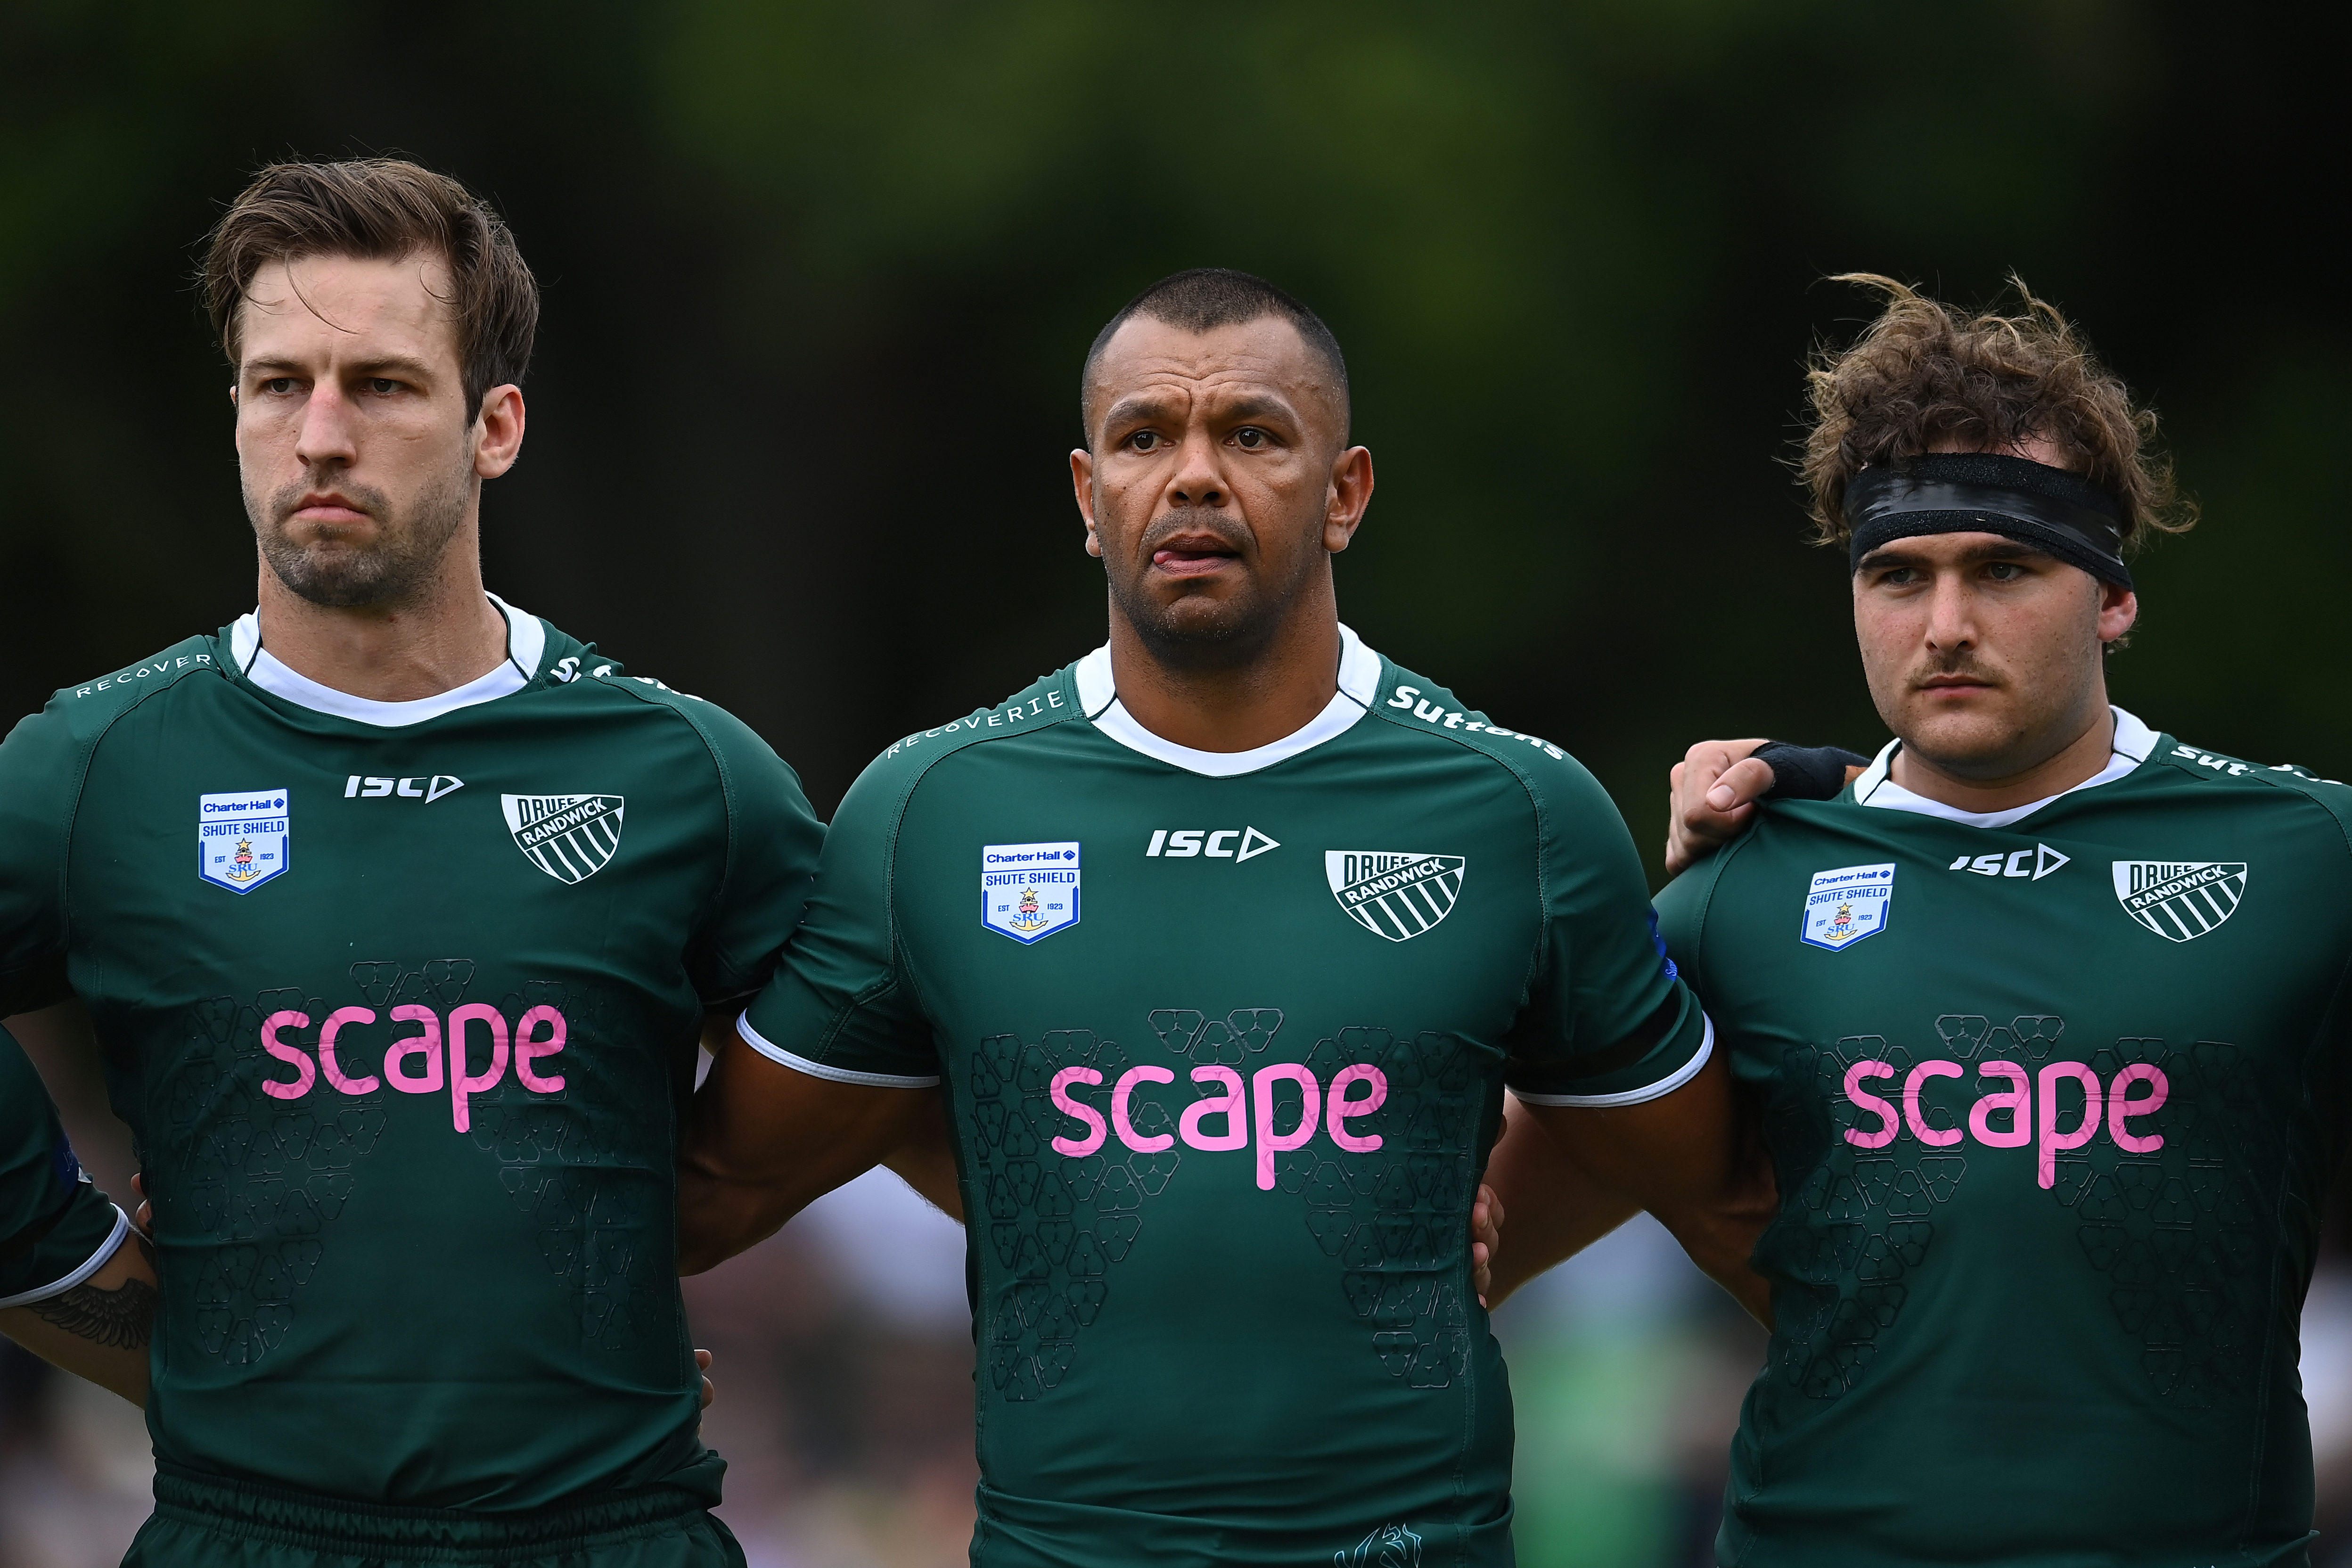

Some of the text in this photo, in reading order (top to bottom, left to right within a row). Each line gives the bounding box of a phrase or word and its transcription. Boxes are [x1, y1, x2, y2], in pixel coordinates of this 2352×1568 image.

[887, 690, 1064, 759] RECOVERIE
[1387, 685, 1564, 760] Suttons
[344, 775, 427, 798] ISC
[203, 799, 271, 813] Charter Hall
[203, 821, 285, 837] SHUTE SHIELD
[521, 797, 608, 846] RANDWICK
[1146, 829, 1240, 857] ISC
[214, 855, 226, 863] EST
[986, 851, 1060, 863] Charter Hall
[1949, 849, 2033, 878] ISC
[228, 863, 258, 873] SRU
[985, 872, 1075, 886] SHUTE SHIELD
[1344, 858, 1446, 904] RANDWICK
[1814, 871, 1878, 886] Charter Hall
[2130, 865, 2228, 909] RANDWICK
[1809, 887, 1887, 906] SHUTE SHIELD
[998, 904, 1010, 912] EST
[1012, 913, 1045, 922] SRU
[1815, 919, 1827, 927] EST
[1827, 923, 1855, 934] SRU
[261, 1003, 567, 1133] scape
[1050, 1063, 1388, 1190] scape
[1844, 1060, 2169, 1190] scape
